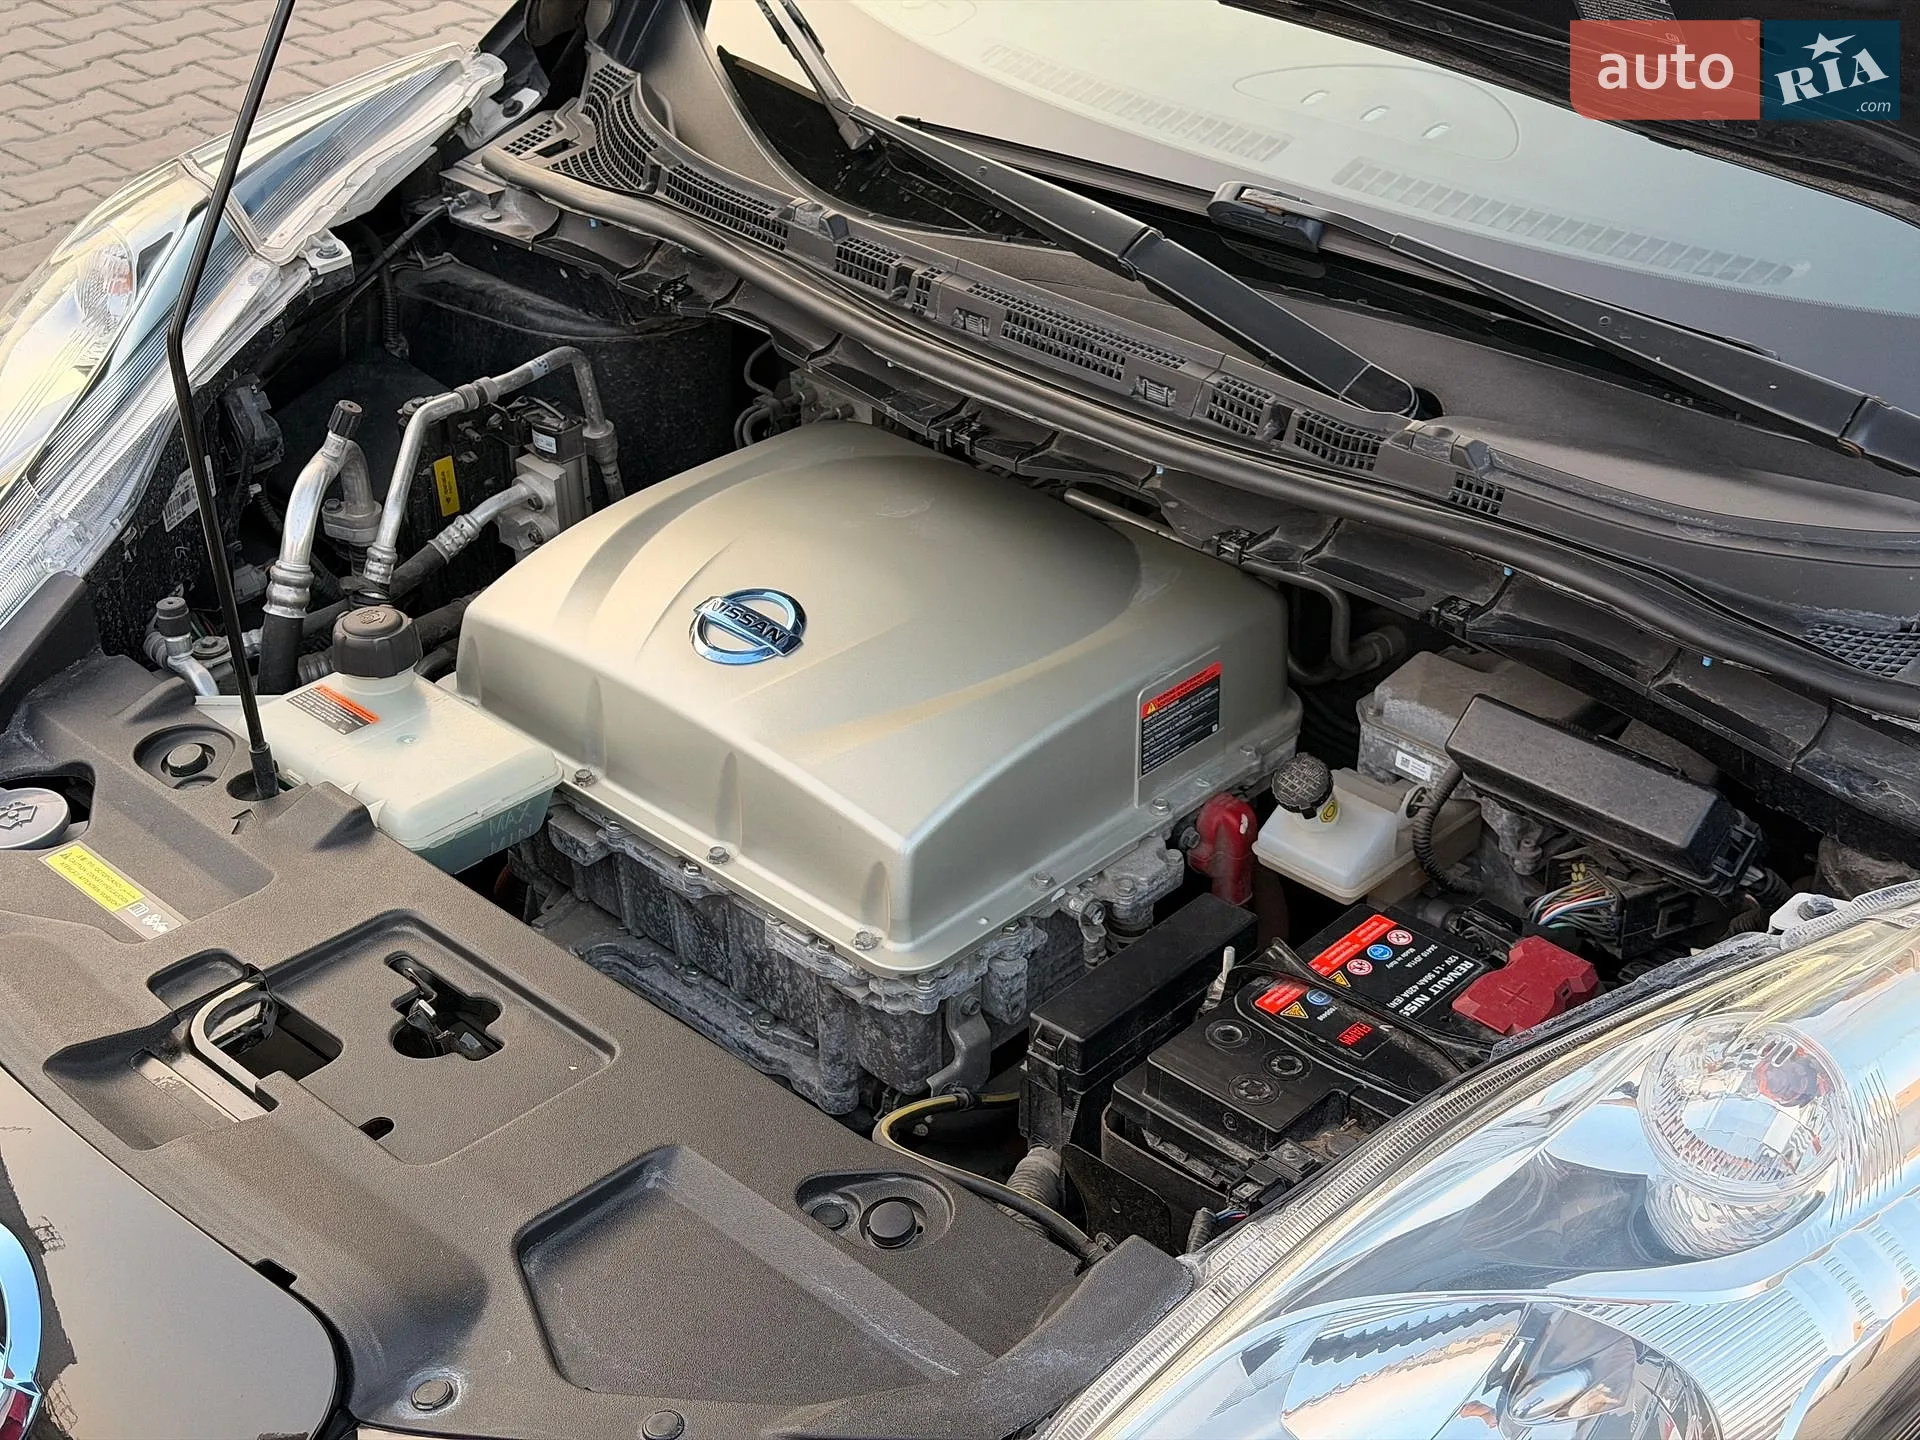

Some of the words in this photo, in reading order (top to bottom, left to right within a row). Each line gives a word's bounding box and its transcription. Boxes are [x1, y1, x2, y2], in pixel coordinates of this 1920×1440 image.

[704, 598, 789, 643] NISSAN
[489, 801, 533, 837] MAX
[490, 823, 532, 854] MIN
[1400, 947, 1416, 958] Made
[1385, 960, 1399, 969] Italy
[1444, 954, 1459, 966] 12V
[1416, 972, 1436, 986] 50Ah
[1428, 960, 1475, 996] RENAULT
[1400, 984, 1420, 998] 420A
[1386, 995, 1405, 1009] (EN)
